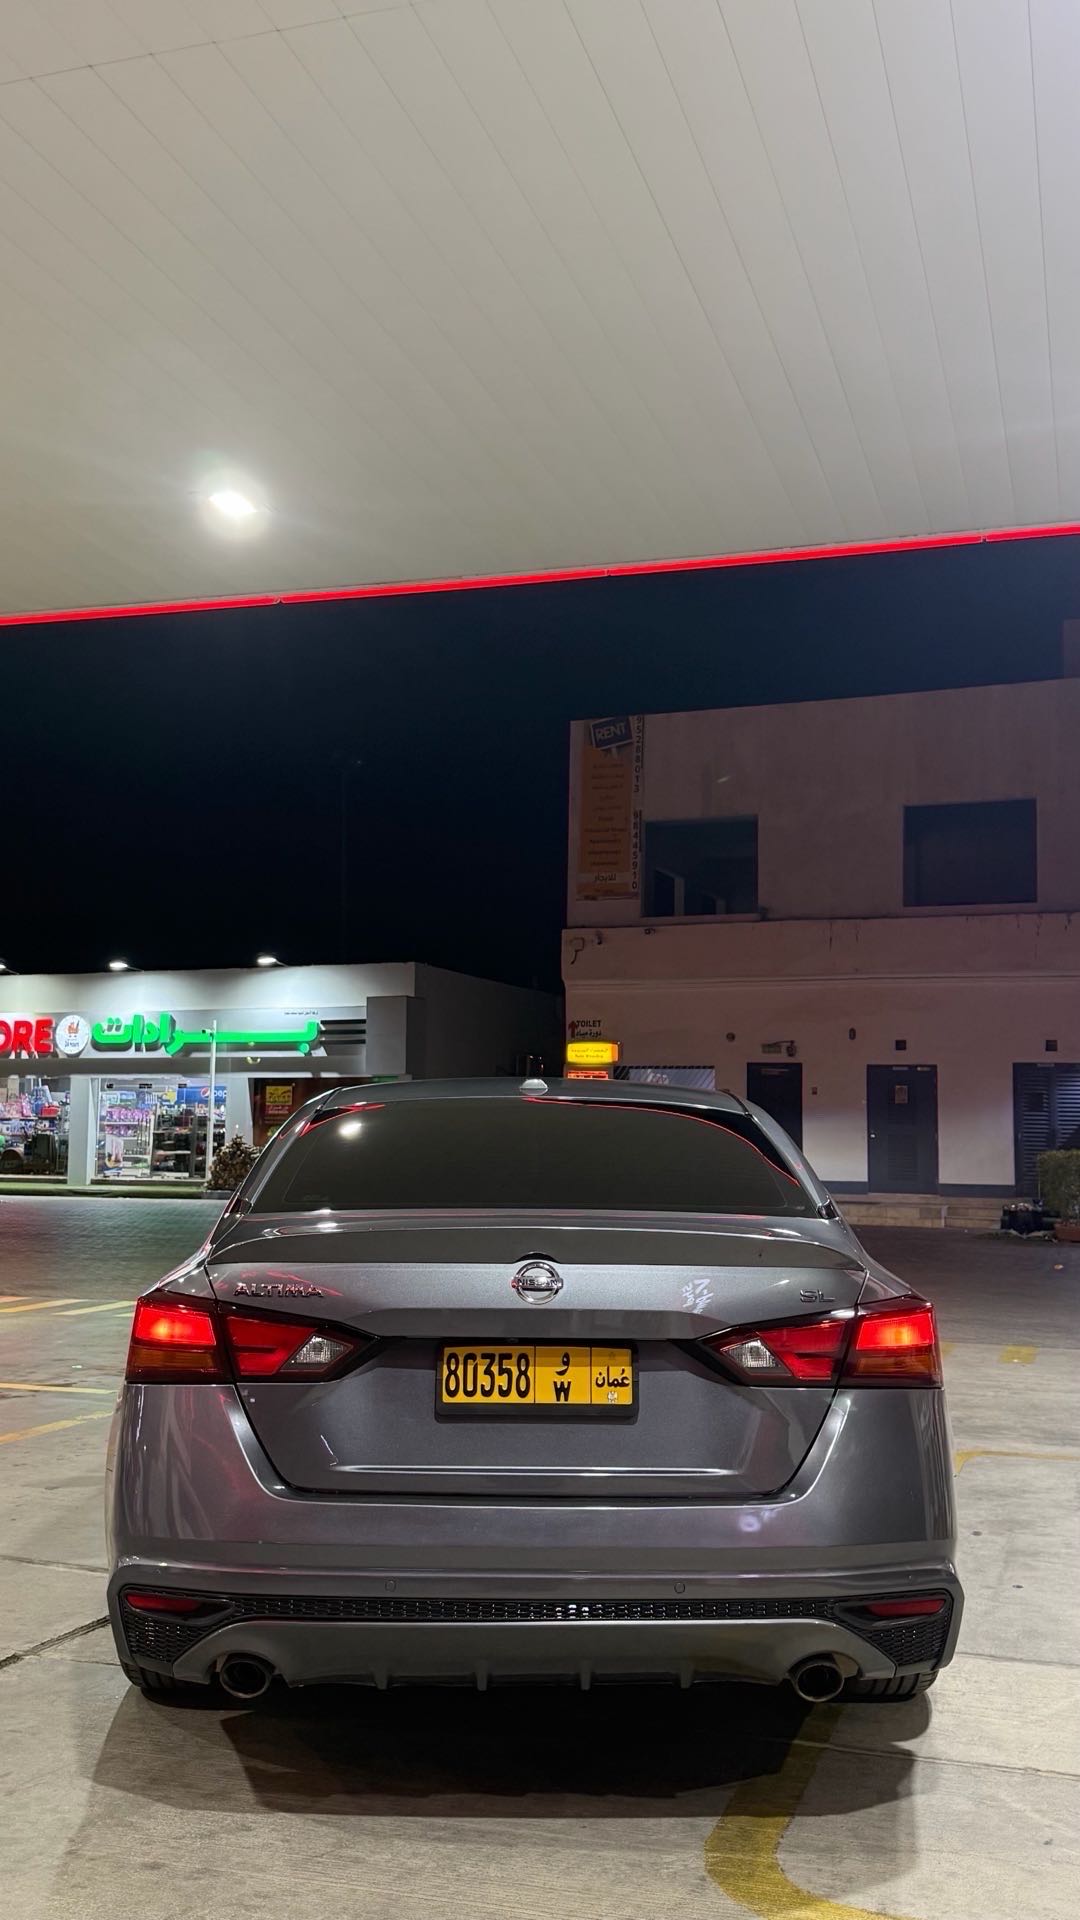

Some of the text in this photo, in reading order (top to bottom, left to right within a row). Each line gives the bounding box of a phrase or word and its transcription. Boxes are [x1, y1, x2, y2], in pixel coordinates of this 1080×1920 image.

[595, 723, 625, 742] RENT
[576, 1020, 601, 1028] TOILET
[91, 1012, 319, 1055] برادات
[233, 1282, 324, 1297] ALTIMA
[800, 1289, 836, 1303] SL
[445, 1352, 530, 1398] 80358
